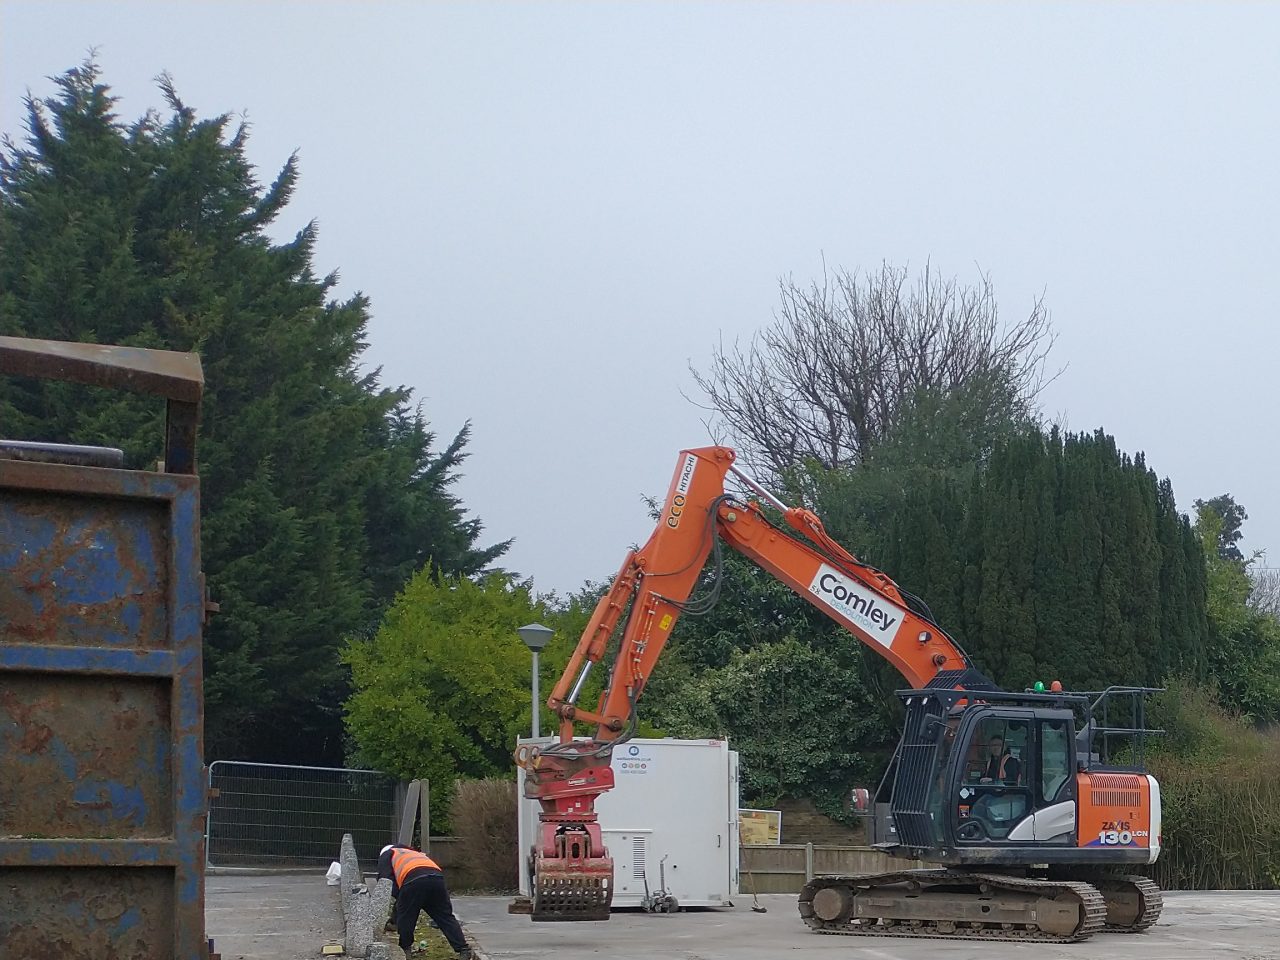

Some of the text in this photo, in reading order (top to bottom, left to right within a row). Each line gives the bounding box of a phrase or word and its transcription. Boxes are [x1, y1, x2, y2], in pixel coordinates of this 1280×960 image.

[679, 456, 695, 492] HITACHI
[819, 573, 896, 631] Comley
[1098, 830, 1132, 845] 130
